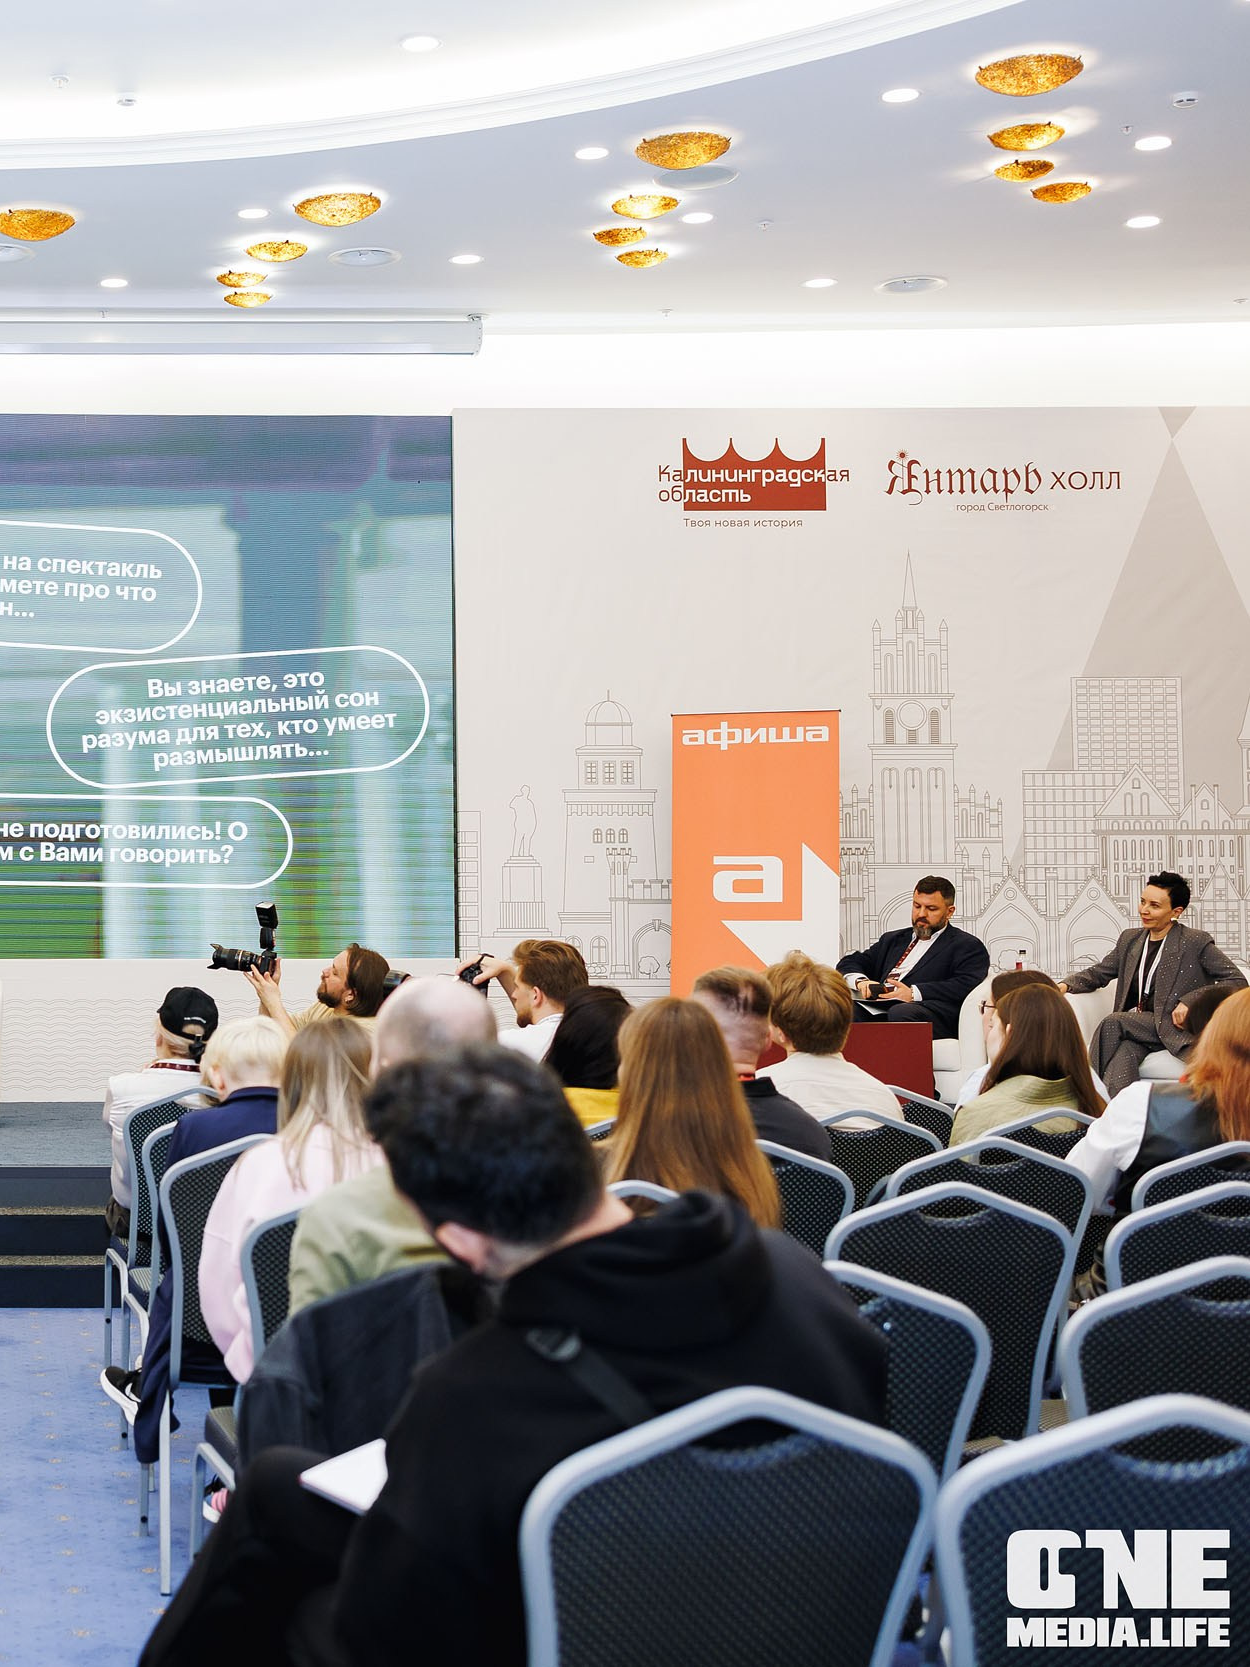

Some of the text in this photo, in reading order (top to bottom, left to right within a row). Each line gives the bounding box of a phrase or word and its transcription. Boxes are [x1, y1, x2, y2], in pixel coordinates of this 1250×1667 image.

[658, 464, 850, 487] Калининградская
[885, 453, 1042, 505] Янтарь
[658, 485, 751, 503] область
[956, 502, 1049, 513] город Светлогорск
[683, 518, 803, 529] Твоя новая история
[3, 554, 32, 571] на
[37, 556, 163, 579] спектакль
[64, 580, 110, 602] про
[115, 584, 157, 601] что
[147, 670, 325, 698] Вы знаете, это
[95, 689, 380, 725] экзистенциальный сон
[81, 712, 397, 753] разума для тех, кто умеет
[682, 721, 830, 751] афиша
[153, 740, 330, 771] размышлять...
[29, 820, 222, 842] подготовились!
[227, 821, 248, 841] О
[19, 845, 35, 861] с
[39, 843, 103, 862] Вами
[109, 844, 234, 867] говорить?
